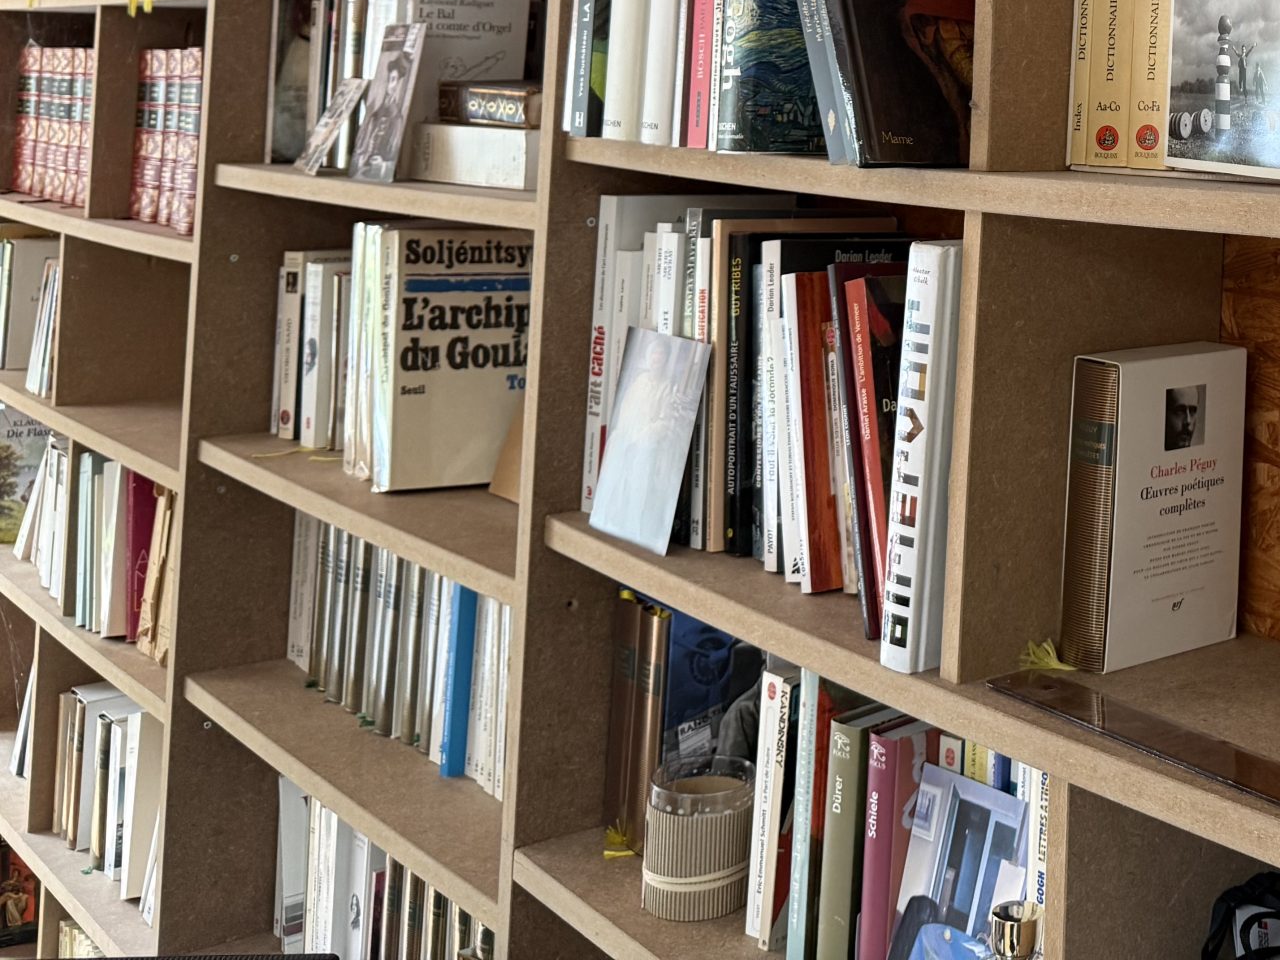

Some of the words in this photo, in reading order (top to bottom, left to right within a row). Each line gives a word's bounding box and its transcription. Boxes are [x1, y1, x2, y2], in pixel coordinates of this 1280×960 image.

[419, 7, 434, 19] Le
[437, 8, 455, 20] Bal
[582, 2, 591, 23] LA
[434, 21, 470, 33] comte
[472, 21, 512, 34] d'Orgel
[1073, 102, 1083, 131] Index
[1096, 101, 1121, 112] Aa-Co
[881, 131, 914, 145] Mame
[404, 238, 533, 269] Soljénitsy
[732, 257, 742, 289] RIBES
[732, 291, 740, 316] GUY
[854, 333, 862, 344] de
[400, 338, 440, 372] du
[731, 341, 740, 390] FAUSSAIRE
[855, 345, 866, 382] L'ambition
[400, 385, 426, 396] Seuil
[859, 388, 868, 414] Arasse
[730, 392, 739, 420] D'UN
[863, 414, 872, 441] Daniel
[727, 421, 738, 495] AUTOPORTRAIT
[1149, 463, 1188, 480] Charles
[1190, 458, 1218, 476] Péguy
[1139, 484, 1179, 502] Œuvres
[1180, 474, 1225, 497] poétiques
[1158, 497, 1206, 517] complètes
[832, 774, 843, 814] Dürer
[868, 790, 879, 839] Schiele
